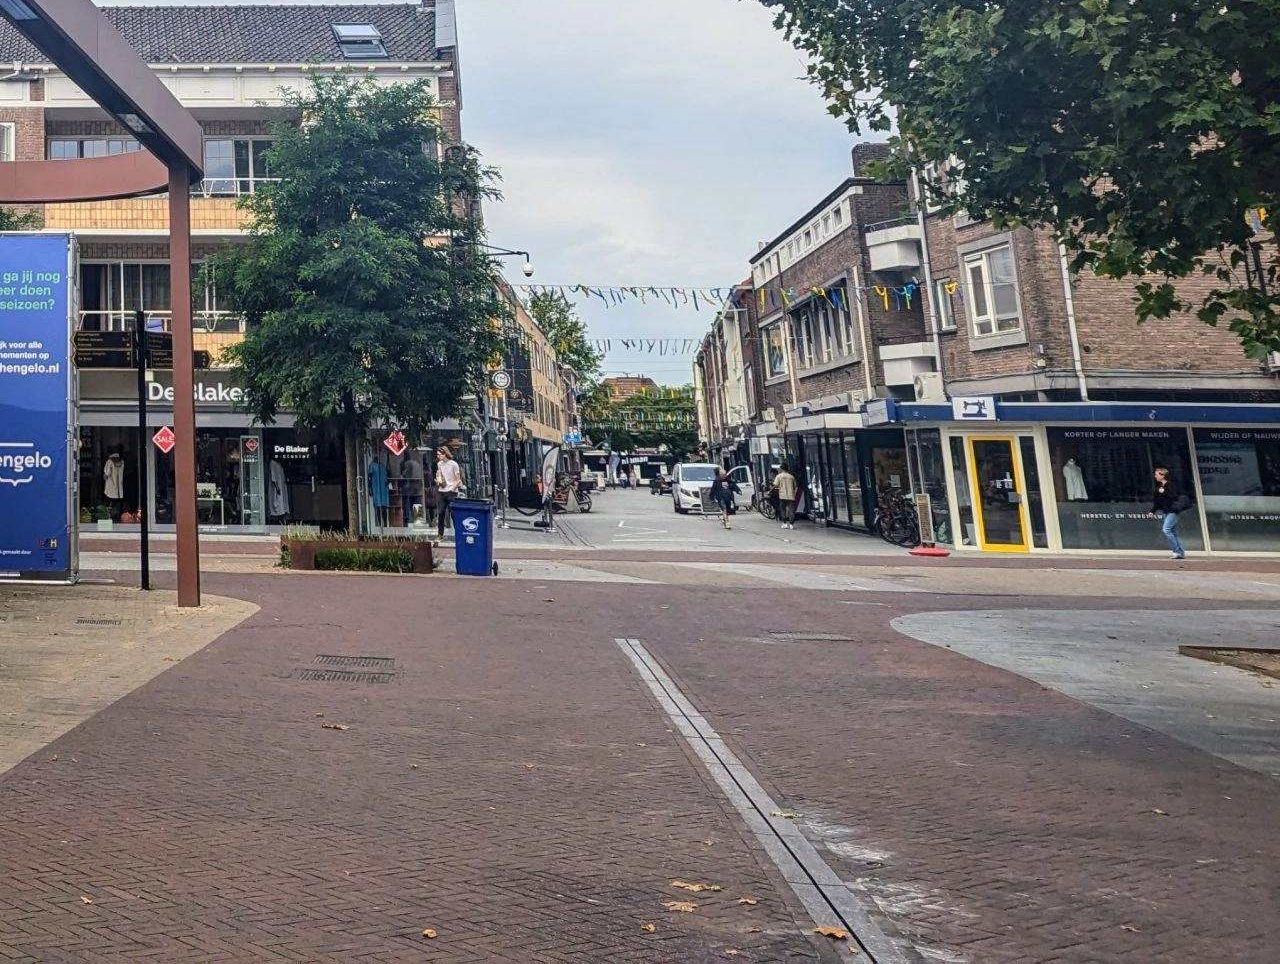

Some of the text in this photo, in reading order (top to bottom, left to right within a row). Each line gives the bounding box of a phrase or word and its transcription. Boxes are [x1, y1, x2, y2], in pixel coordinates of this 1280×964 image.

[3, 272, 19, 284] ga
[22, 270, 33, 284] jij
[36, 272, 61, 284] nog
[19, 285, 51, 296] doen
[0, 298, 55, 310] seizoen?
[8, 341, 26, 349] voor
[27, 340, 43, 349] alle
[38, 352, 50, 361] op
[148, 382, 174, 401] De
[1109, 431, 1140, 439] LANGER
[1141, 431, 1169, 439] MAKEN
[274, 445, 310, 453] De Blaker
